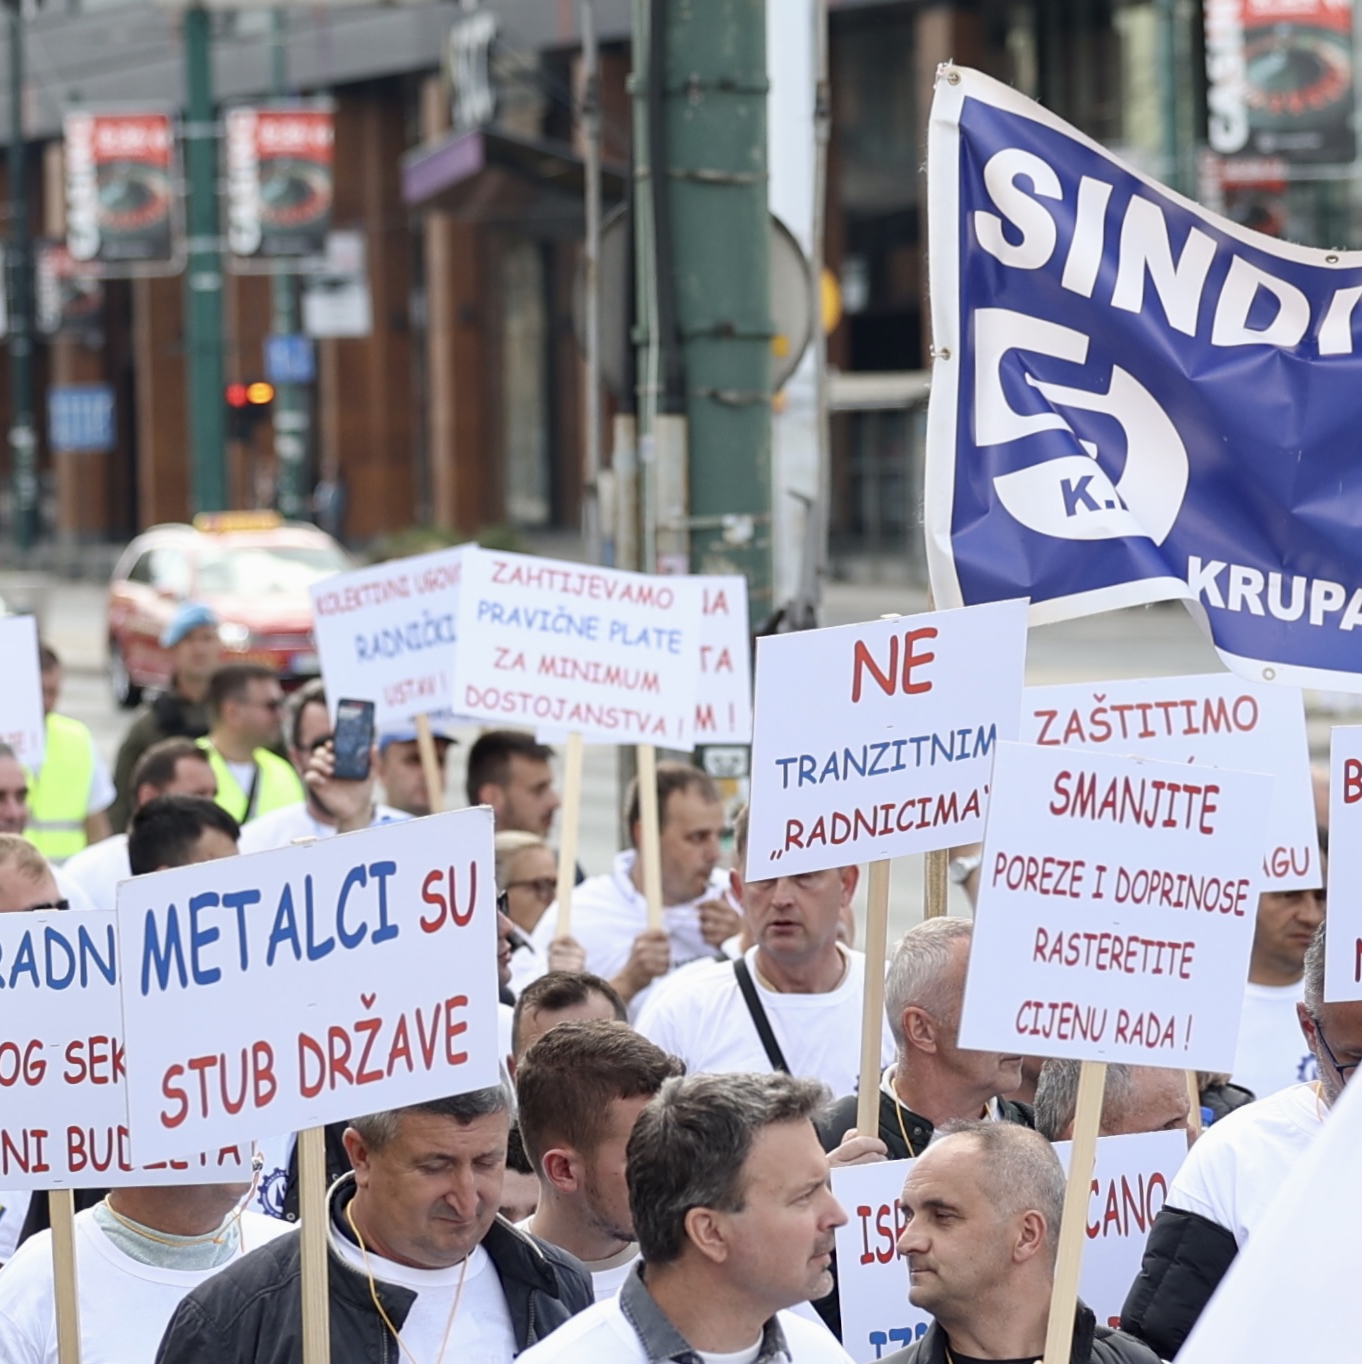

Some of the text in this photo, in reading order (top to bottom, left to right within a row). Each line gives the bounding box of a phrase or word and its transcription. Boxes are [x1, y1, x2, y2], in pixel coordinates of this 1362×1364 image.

[492, 561, 674, 608] ZAHTIJEVAMO
[355, 610, 456, 663] RADNIČKI
[477, 599, 683, 654] PRAVIČNE PLATE
[493, 647, 660, 694] ZA MINIMUM
[851, 627, 938, 703] NE
[465, 684, 667, 736] DOSTOJANSTVA
[1034, 694, 1259, 746] ZAŠTITIMO
[776, 723, 997, 789] TRANZITNIM
[1049, 770, 1220, 835] SMANJITE
[992, 851, 1250, 917] POREZE I DOPRINOSE
[140, 860, 477, 996] METALCI SU
[1033, 927, 1196, 980] RASTERETITE
[1015, 1000, 1193, 1051] CIJENU RADA !
[160, 992, 468, 1128] STUB DRŽAVE
[2, 1128, 49, 1174] NI
